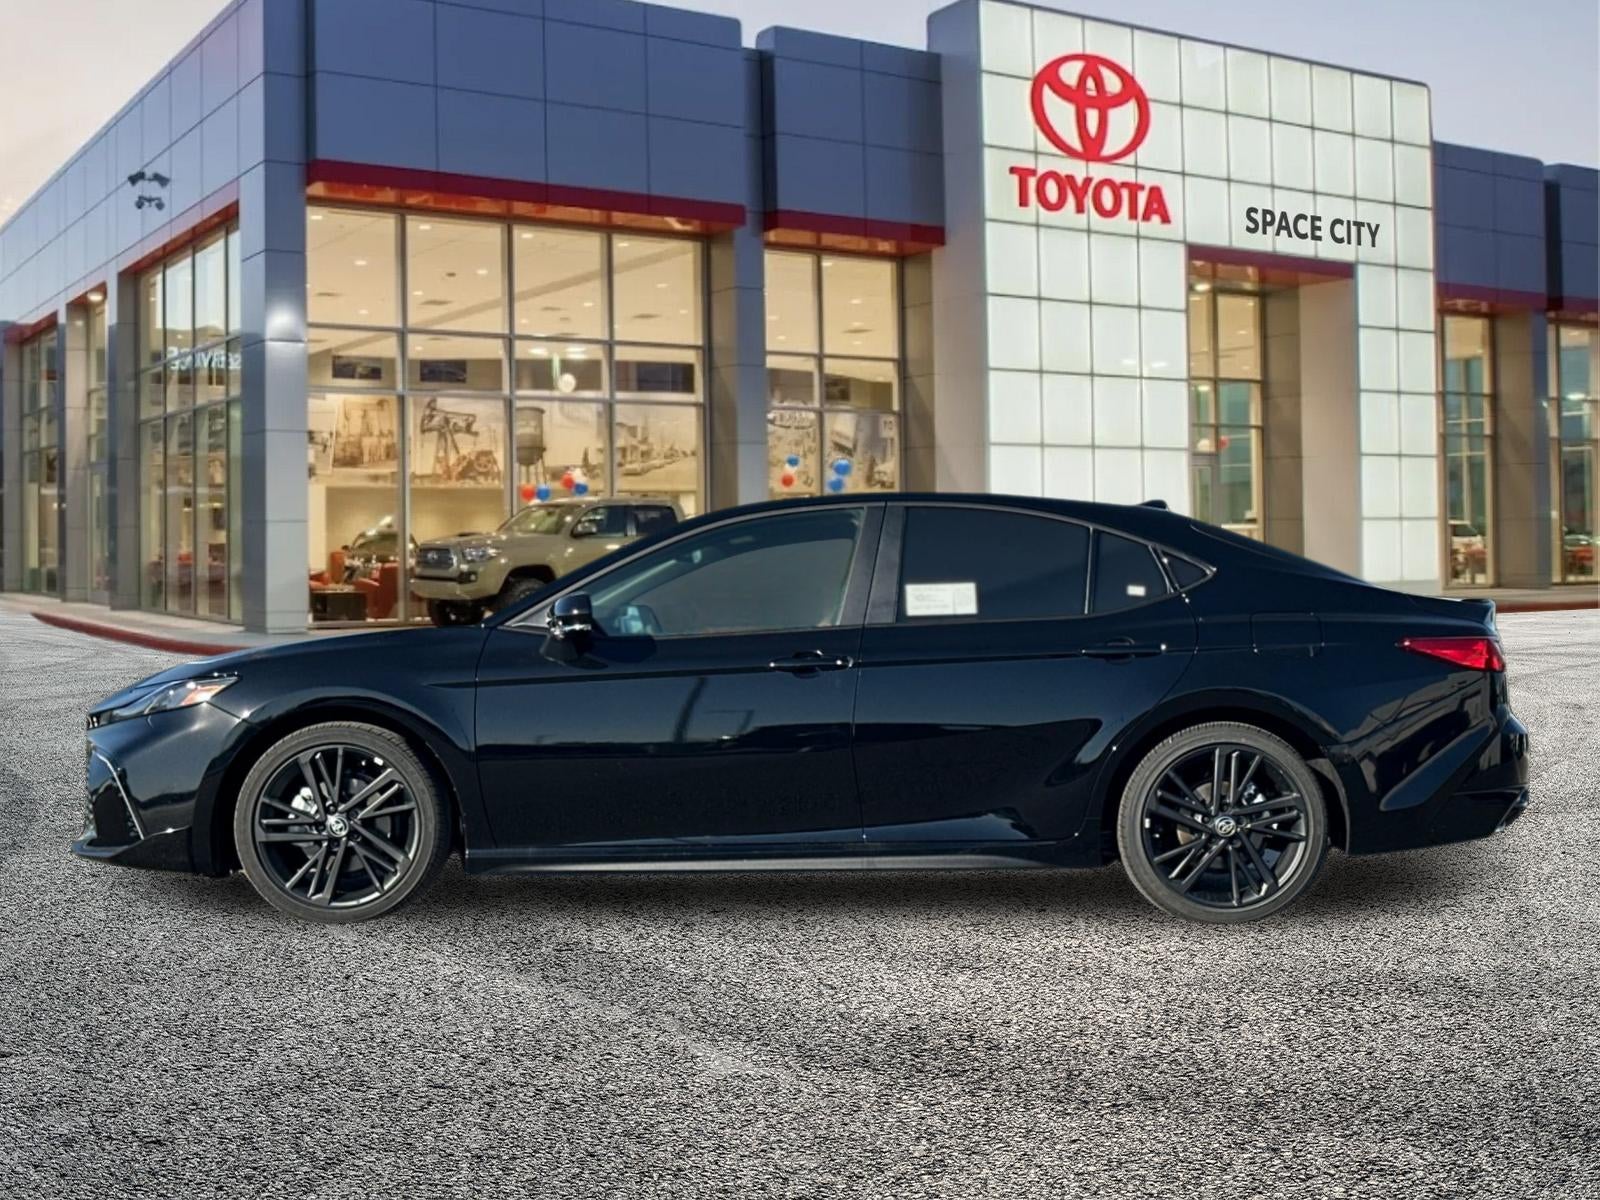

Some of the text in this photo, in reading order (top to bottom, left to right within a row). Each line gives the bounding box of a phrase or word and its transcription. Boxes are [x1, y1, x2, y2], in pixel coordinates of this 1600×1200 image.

[1009, 166, 1171, 225] TOYOTA
[1245, 206, 1380, 248] SPACE CITY
